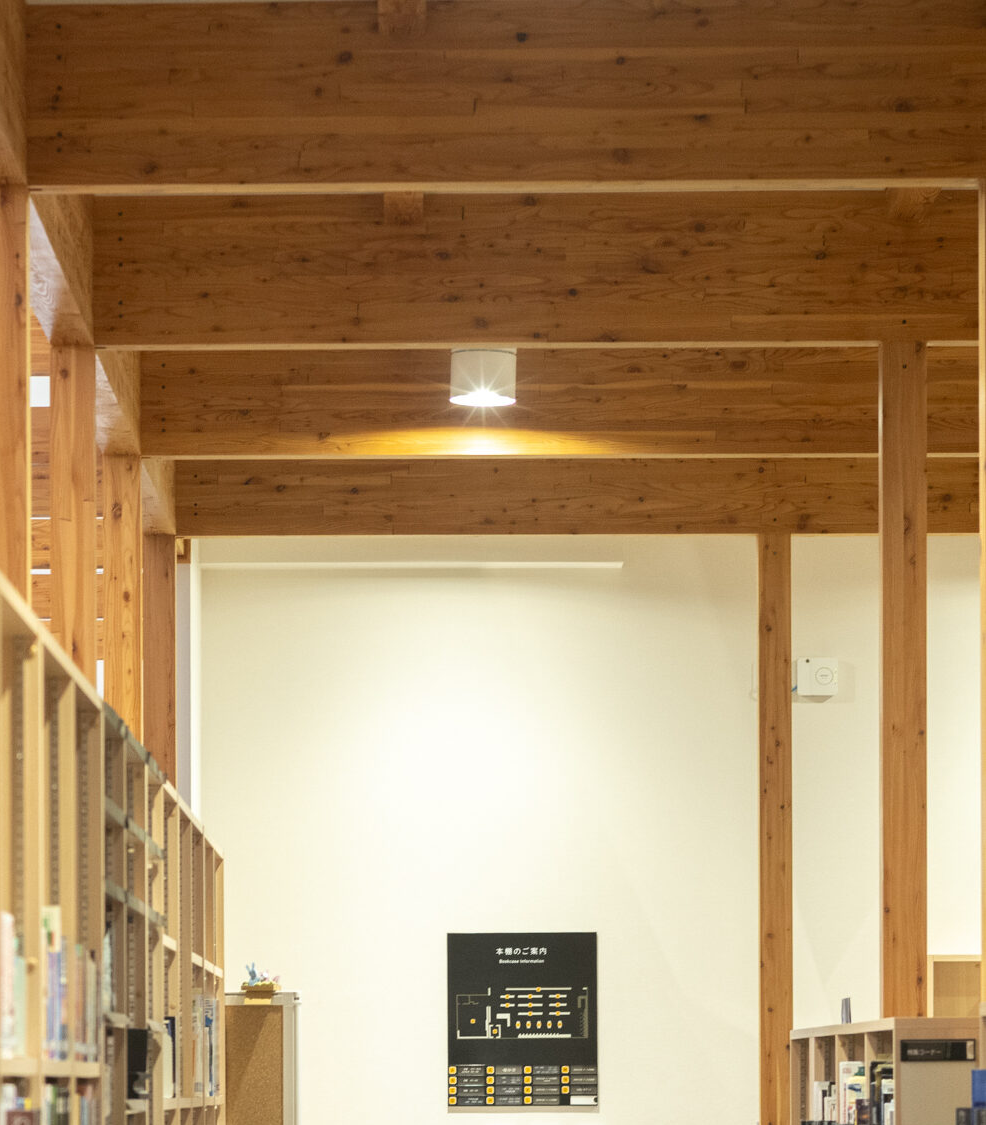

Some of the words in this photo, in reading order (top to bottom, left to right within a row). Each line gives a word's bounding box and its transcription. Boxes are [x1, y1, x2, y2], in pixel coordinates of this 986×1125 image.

[495, 947, 547, 956] 本棚のご案内
